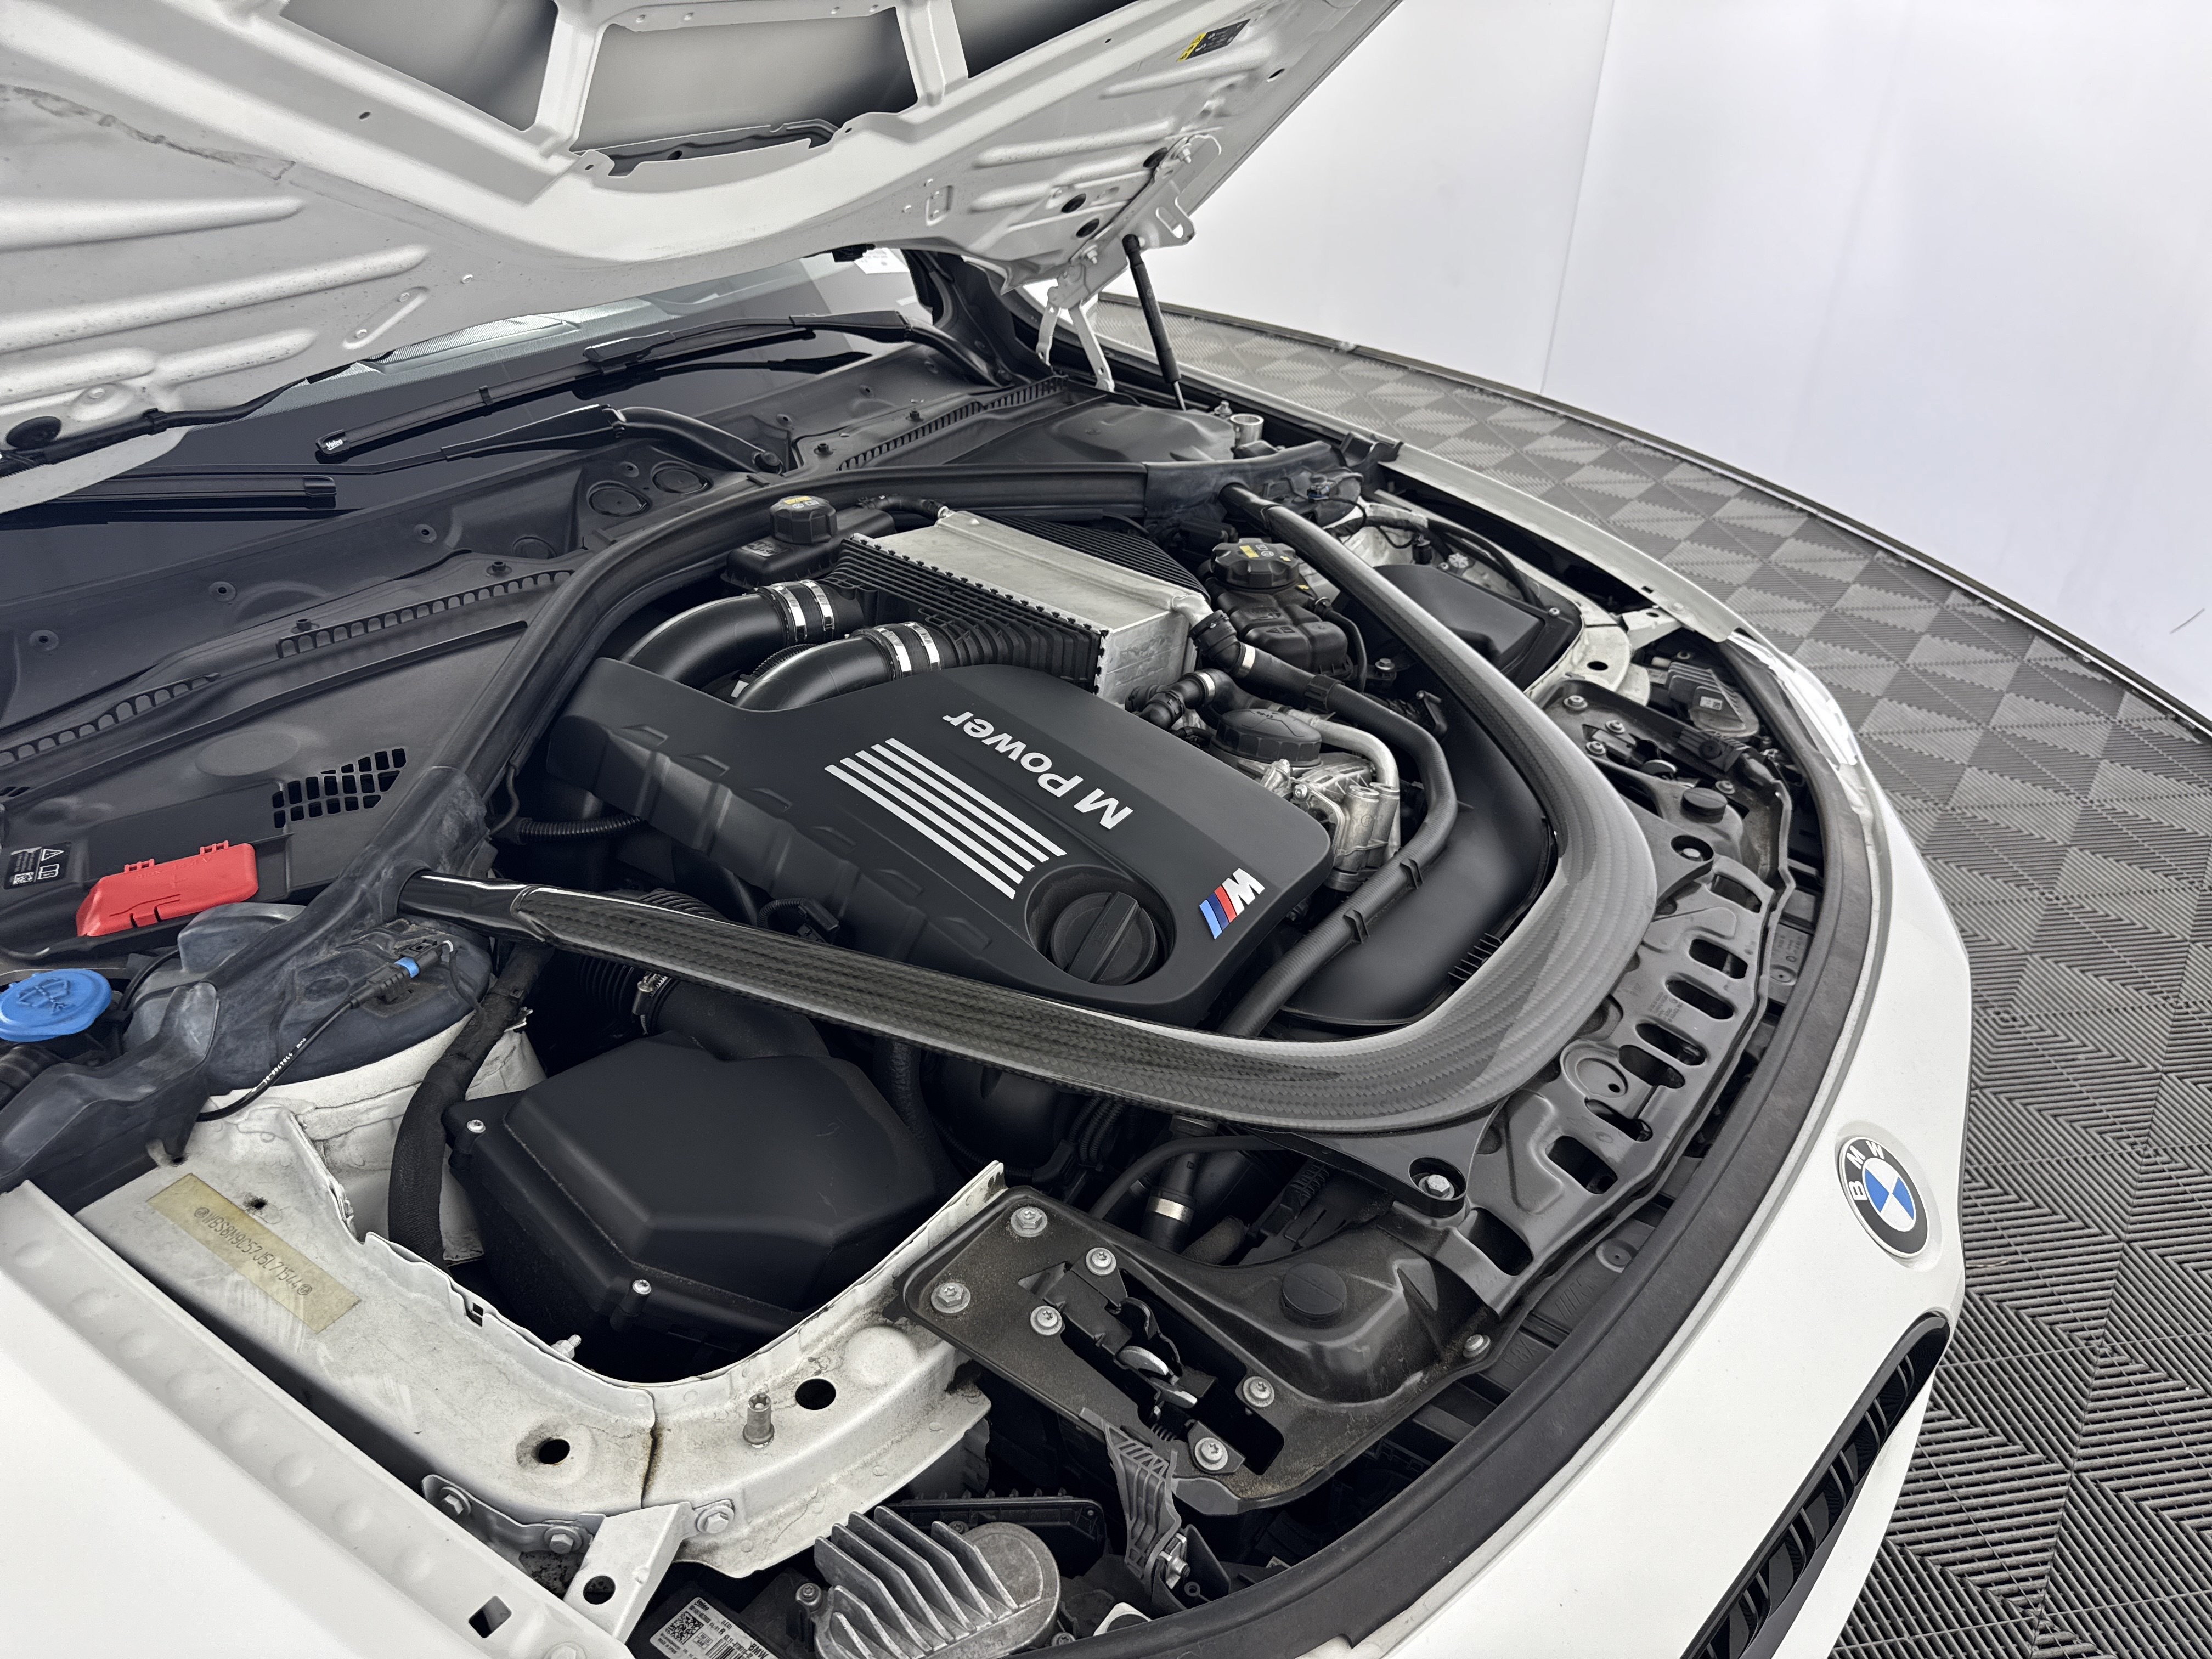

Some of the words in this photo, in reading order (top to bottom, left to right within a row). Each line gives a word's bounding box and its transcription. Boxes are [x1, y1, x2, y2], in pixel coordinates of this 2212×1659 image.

[325, 439, 343, 450] Valeo
[942, 711, 1084, 798] Power
[1073, 788, 1133, 830] M
[1847, 1140, 1885, 1200] BMW
[748, 1643, 769, 1659] BMW
